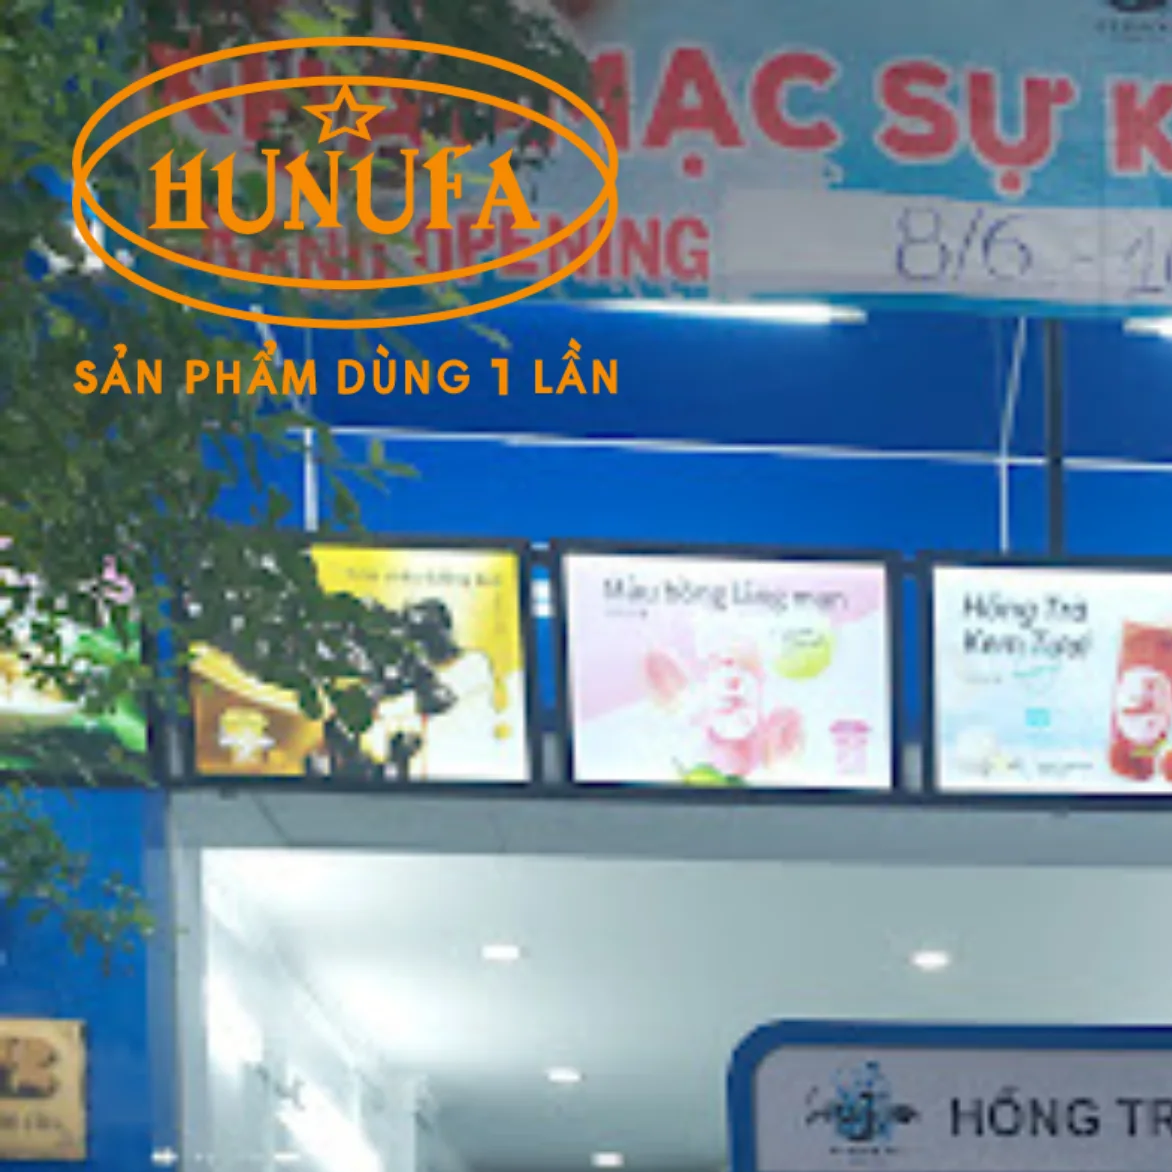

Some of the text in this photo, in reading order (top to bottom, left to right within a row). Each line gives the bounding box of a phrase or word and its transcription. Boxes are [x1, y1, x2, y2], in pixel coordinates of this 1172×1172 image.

[875, 60, 1076, 193] SỰ
[413, 211, 709, 281] OPENING
[896, 207, 1034, 281] 8/6
